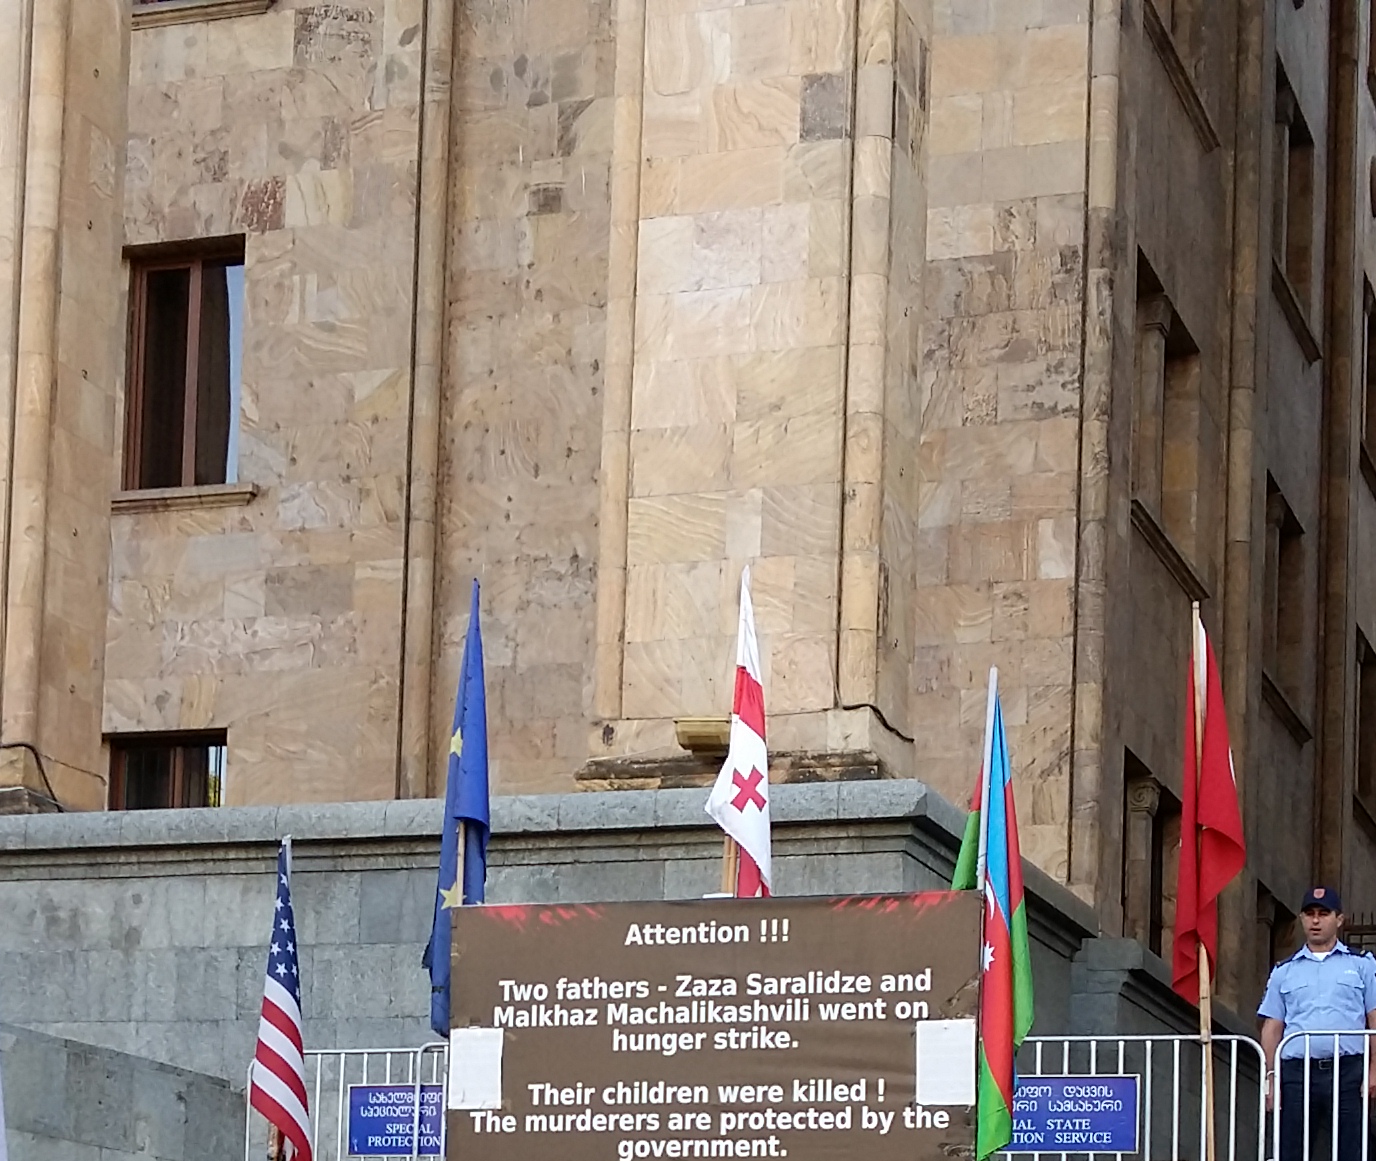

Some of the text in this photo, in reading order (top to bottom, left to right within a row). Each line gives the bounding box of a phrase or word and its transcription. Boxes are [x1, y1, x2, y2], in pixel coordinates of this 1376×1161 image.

[625, 919, 788, 945] Attention !!!
[499, 980, 548, 1001] Two
[556, 977, 649, 999] fathers
[676, 975, 736, 997] Zaza
[747, 971, 871, 995] Saralidze
[880, 968, 931, 992] and
[494, 998, 928, 1027] Malkhaz Machalikashvili went on
[613, 1026, 798, 1055] hunger strike.
[528, 1078, 886, 1105] Their children were killed !
[1064, 1086, 1113, 1097] დაცვის
[1049, 1100, 1123, 1112] სამსახური
[386, 1124, 434, 1134] SPECAL
[470, 1106, 949, 1135] The murderers are protected by the
[1046, 1119, 1091, 1130] STATE
[368, 1136, 441, 1147] PROTECION
[1055, 1132, 1112, 1143] SERVICE
